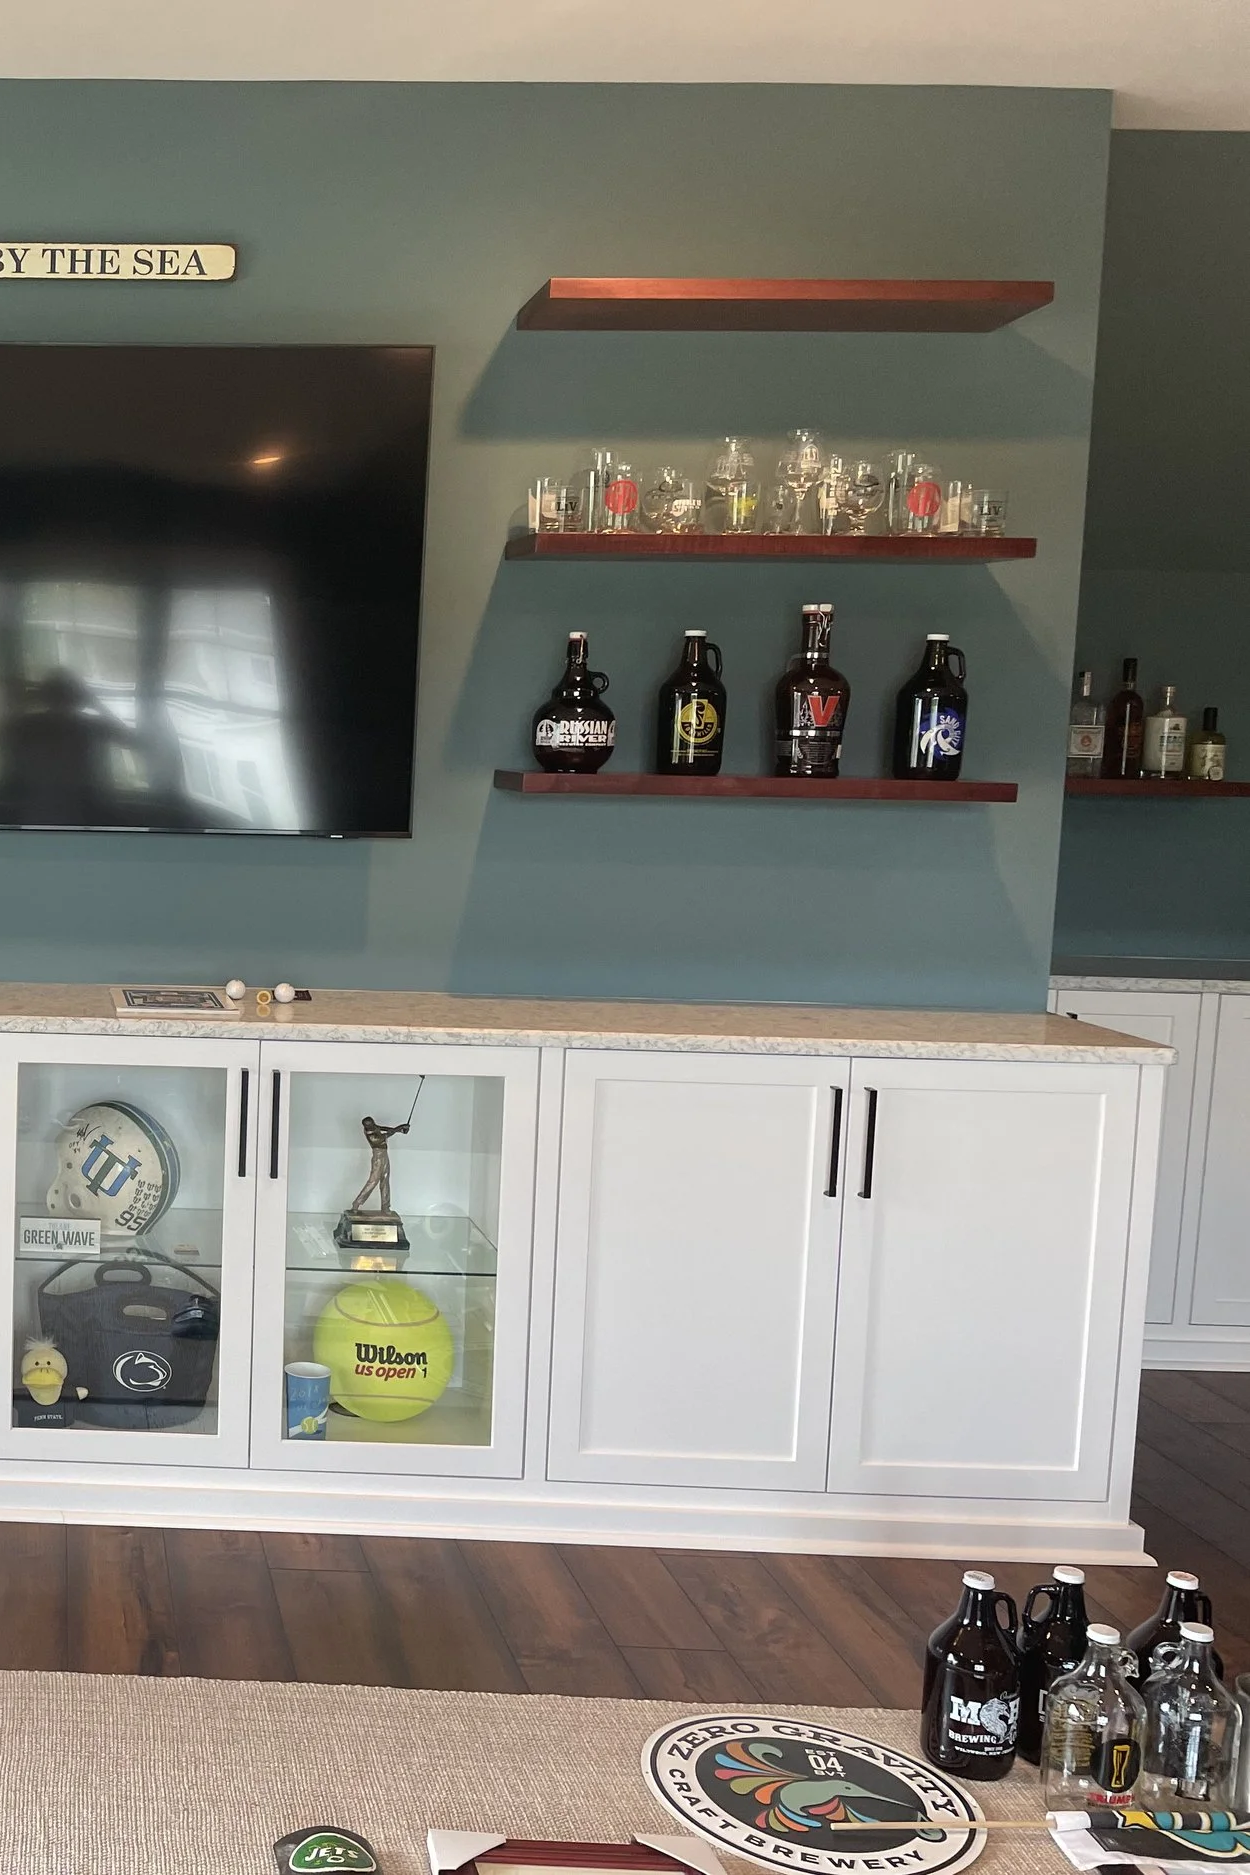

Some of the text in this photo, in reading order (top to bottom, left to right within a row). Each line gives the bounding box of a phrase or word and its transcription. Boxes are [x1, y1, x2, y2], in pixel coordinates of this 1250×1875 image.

[42, 248, 121, 276] THE
[132, 250, 208, 277] SEA
[807, 695, 841, 728] V
[560, 720, 608, 735] RUSSIAN
[940, 715, 960, 730] SAND
[559, 734, 608, 743] RIVER
[115, 1210, 148, 1231] 95
[23, 1230, 95, 1247] GREEN WAVE
[355, 1343, 428, 1365] Wilson
[355, 1364, 427, 1382] us open 1
[949, 1728, 998, 1745] BREWING
[805, 1748, 836, 1757] EST
[667, 1723, 960, 1817] ZERO GRAVITY
[808, 1755, 844, 1772] 04
[813, 1769, 847, 1778] BVT
[668, 1768, 927, 1871] CRAFT BREWERY
[304, 1847, 359, 1862] JETS
